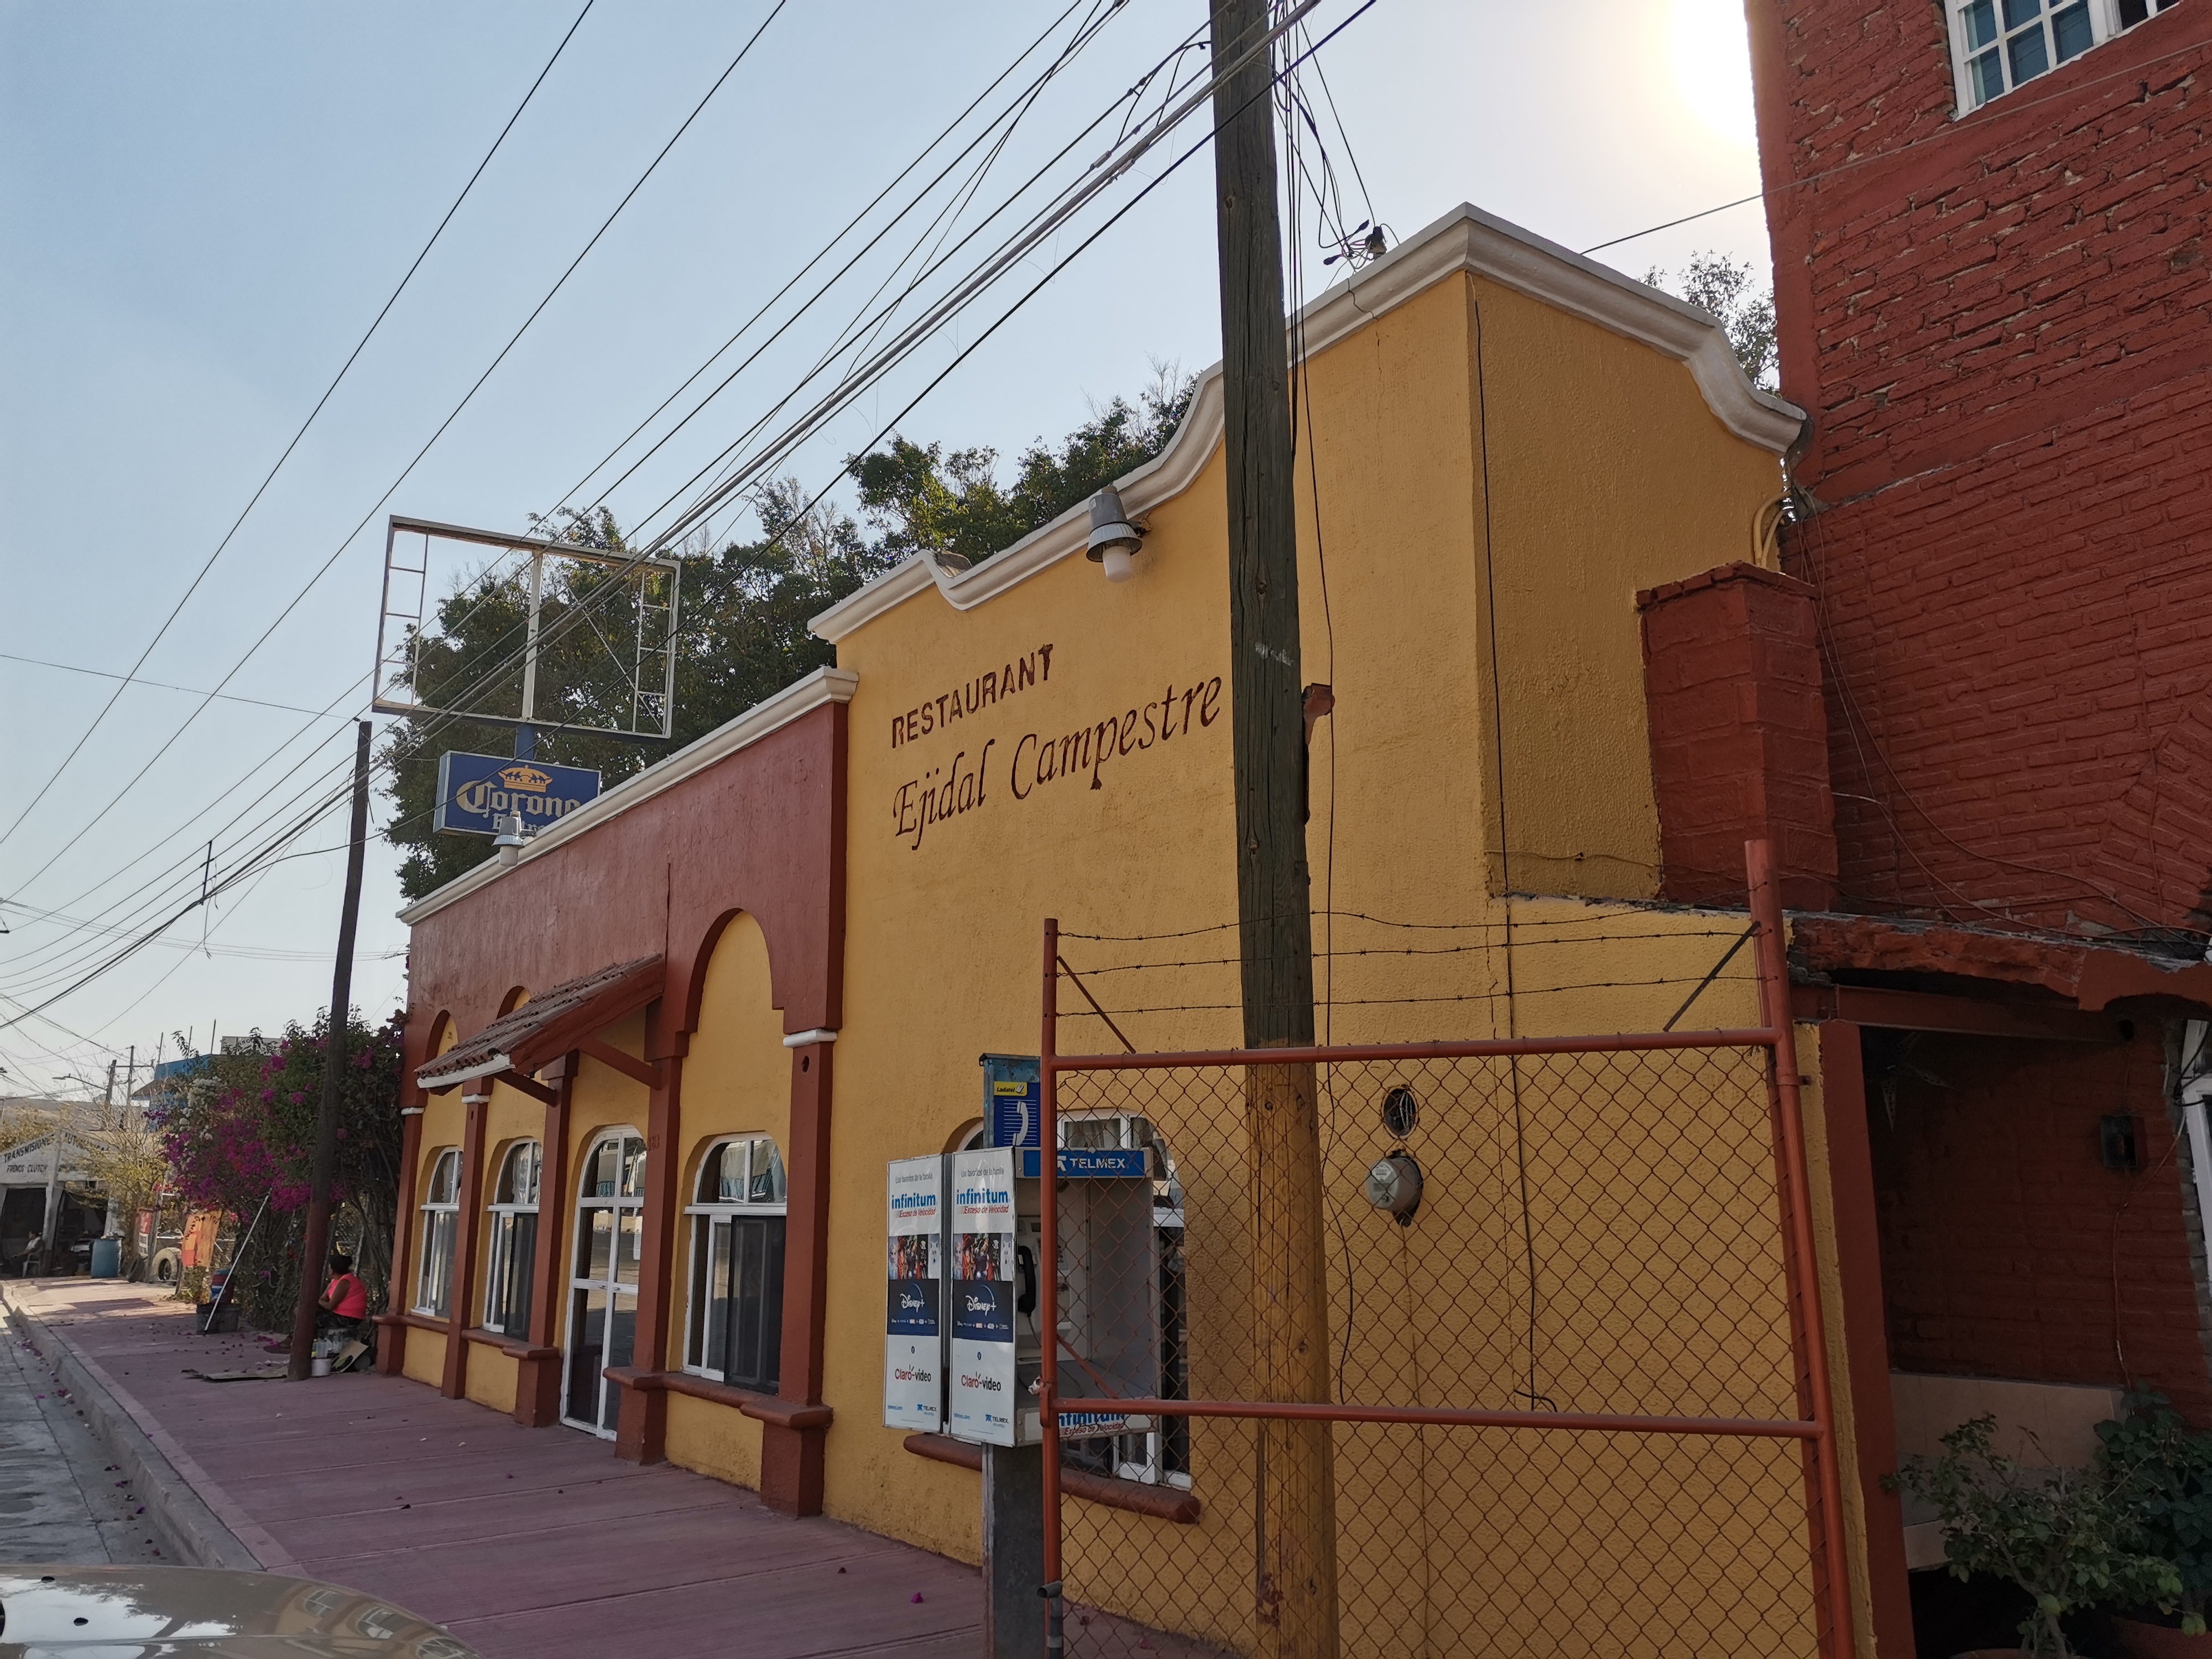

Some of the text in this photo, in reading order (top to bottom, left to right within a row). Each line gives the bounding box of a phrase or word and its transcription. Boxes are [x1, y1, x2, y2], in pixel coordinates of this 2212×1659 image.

[892, 644, 1053, 749] RESTAURANT
[893, 676, 1222, 851] Ejidal Campestre
[1070, 1158, 1125, 1169] TELMEX
[891, 1192, 936, 1209] infinitum
[957, 1188, 1009, 1205] infinitum
[1059, 1413, 1124, 1426] nfinitum
